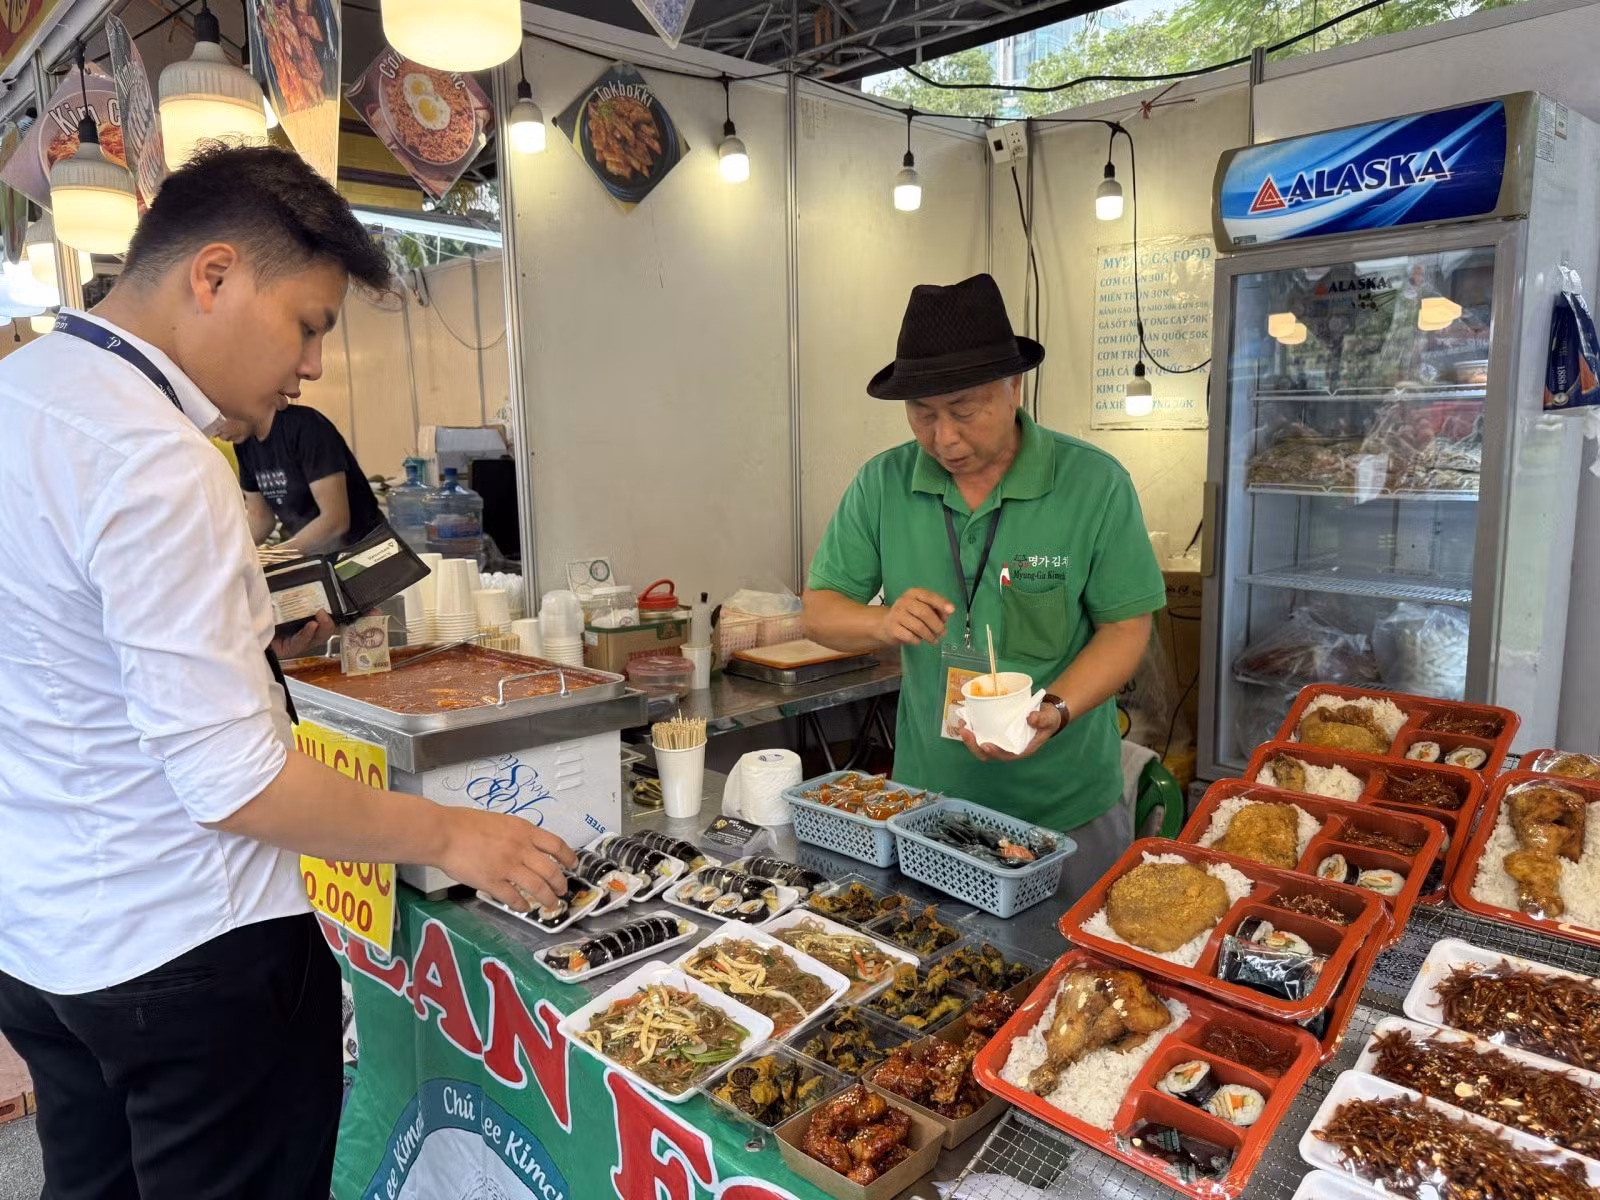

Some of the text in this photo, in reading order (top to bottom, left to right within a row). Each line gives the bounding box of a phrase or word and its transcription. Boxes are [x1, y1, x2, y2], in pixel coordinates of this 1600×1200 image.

[594, 80, 654, 107] Tokbokki
[1287, 149, 1450, 204] ALASKA
[1174, 246, 1212, 263] FOOD
[1150, 288, 1170, 298] 30K
[1328, 276, 1388, 294] ALASKA
[1129, 318, 1148, 327] MT
[1150, 317, 1168, 326] ONG
[1190, 314, 1208, 324] 50K
[1189, 330, 1209, 340] 50K
[1151, 347, 1170, 358] 50K
[1096, 384, 1114, 394] KIM
[585, 814, 606, 834] STEEL
[304, 871, 372, 932] 0.000
[443, 1086, 476, 1121] Chú
[504, 1130, 564, 1200] Kimc
[374, 1167, 399, 1200] ee
